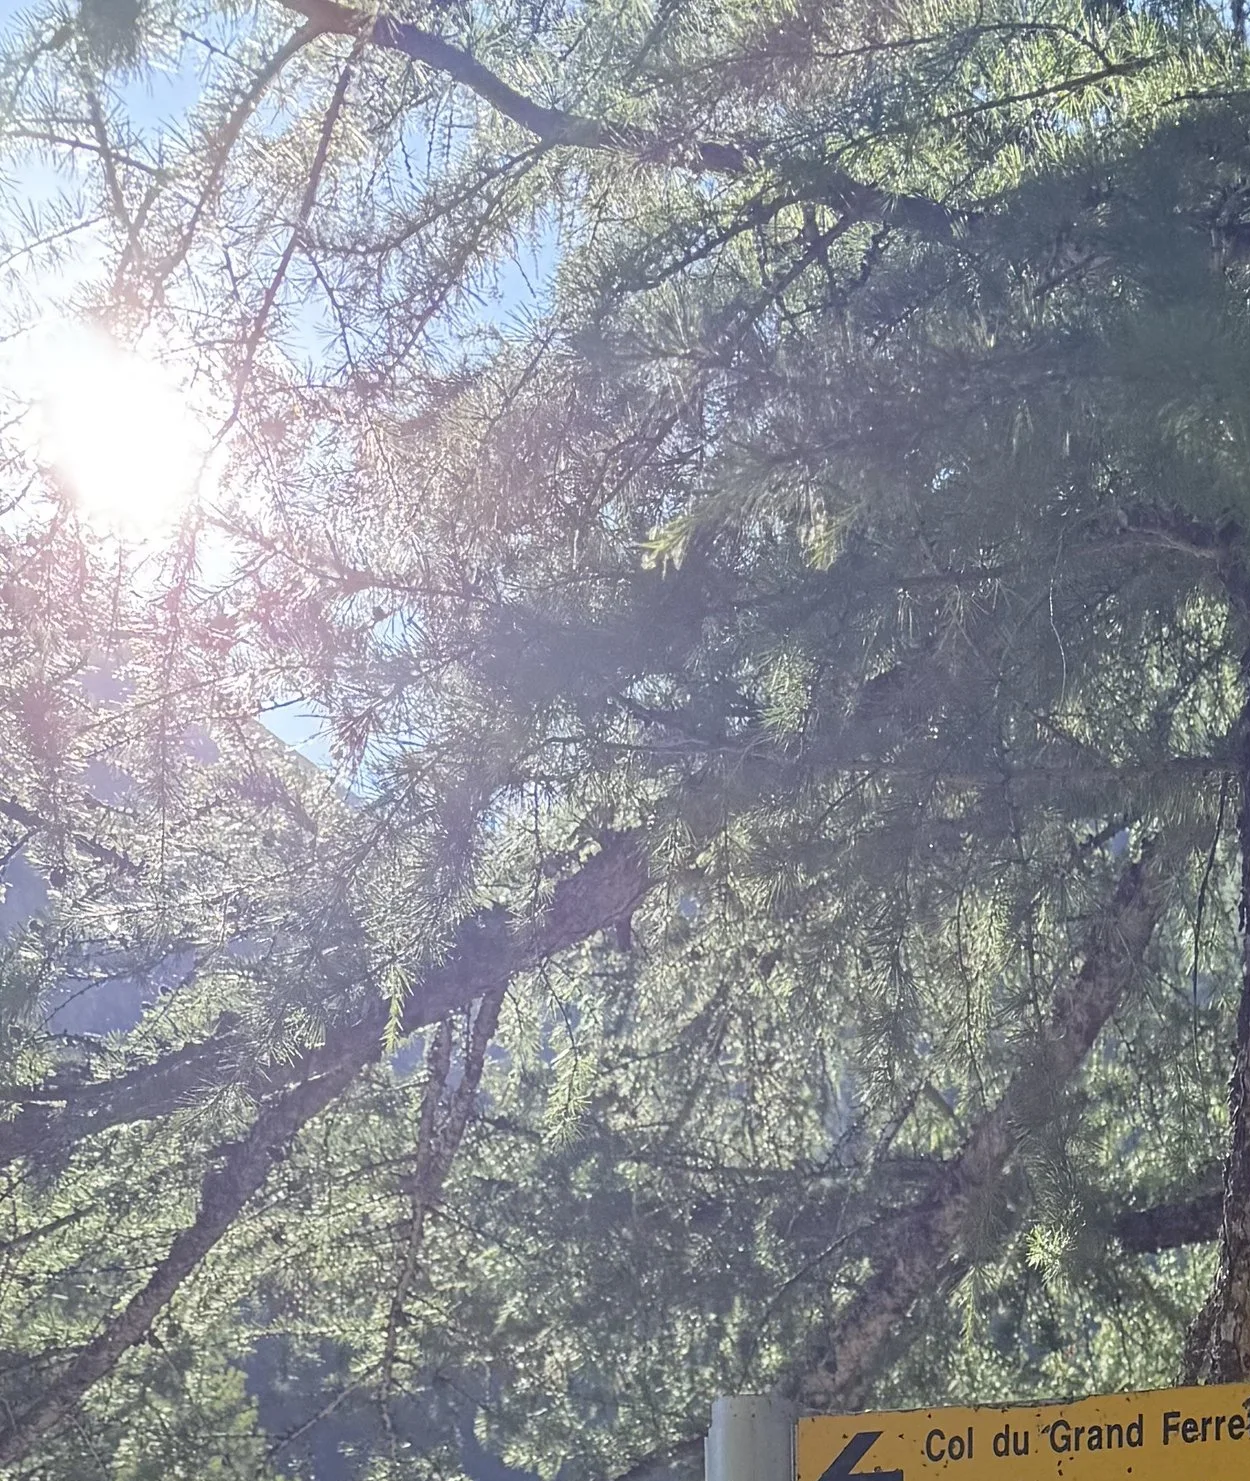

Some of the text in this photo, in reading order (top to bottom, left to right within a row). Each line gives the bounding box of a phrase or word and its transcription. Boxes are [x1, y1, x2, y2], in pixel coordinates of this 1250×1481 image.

[925, 1426, 973, 1462] Col
[992, 1423, 1029, 1458] du
[1049, 1413, 1144, 1455] Grand
